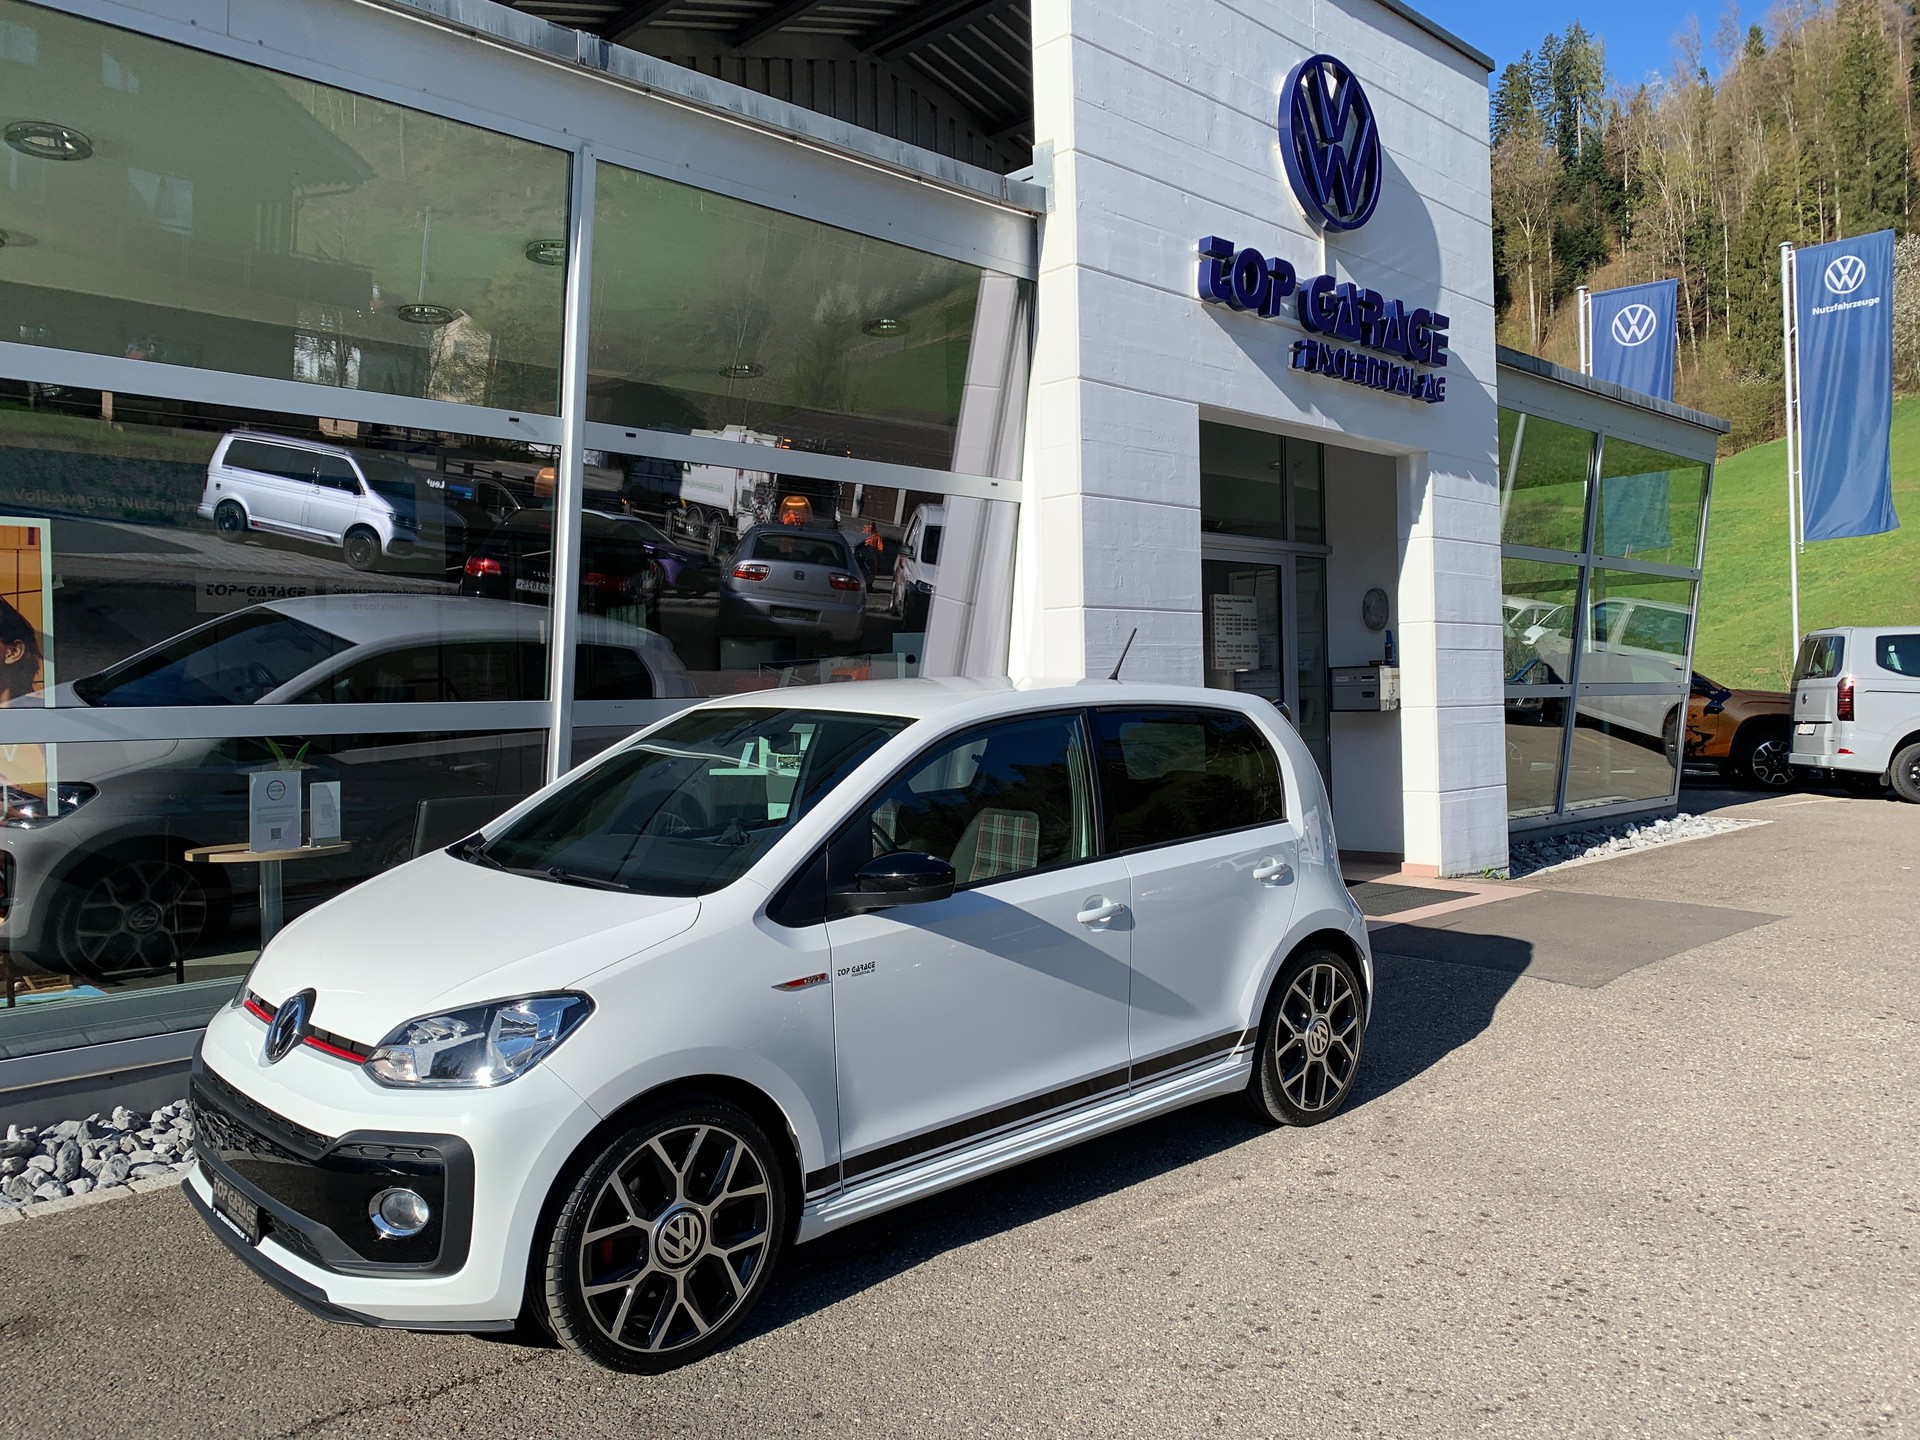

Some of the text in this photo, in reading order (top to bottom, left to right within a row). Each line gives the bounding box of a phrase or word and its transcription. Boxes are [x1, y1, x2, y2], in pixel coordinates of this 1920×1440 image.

[1198, 235, 1449, 368] TOP GARAGE
[1811, 296, 1880, 315] Nutzfahrzeuge
[14, 488, 117, 509] Volkswagen
[837, 967, 850, 976] TOP
[851, 961, 875, 973] GARAGE
[213, 1177, 228, 1201] TOP
[227, 1189, 256, 1226] GARAGE
